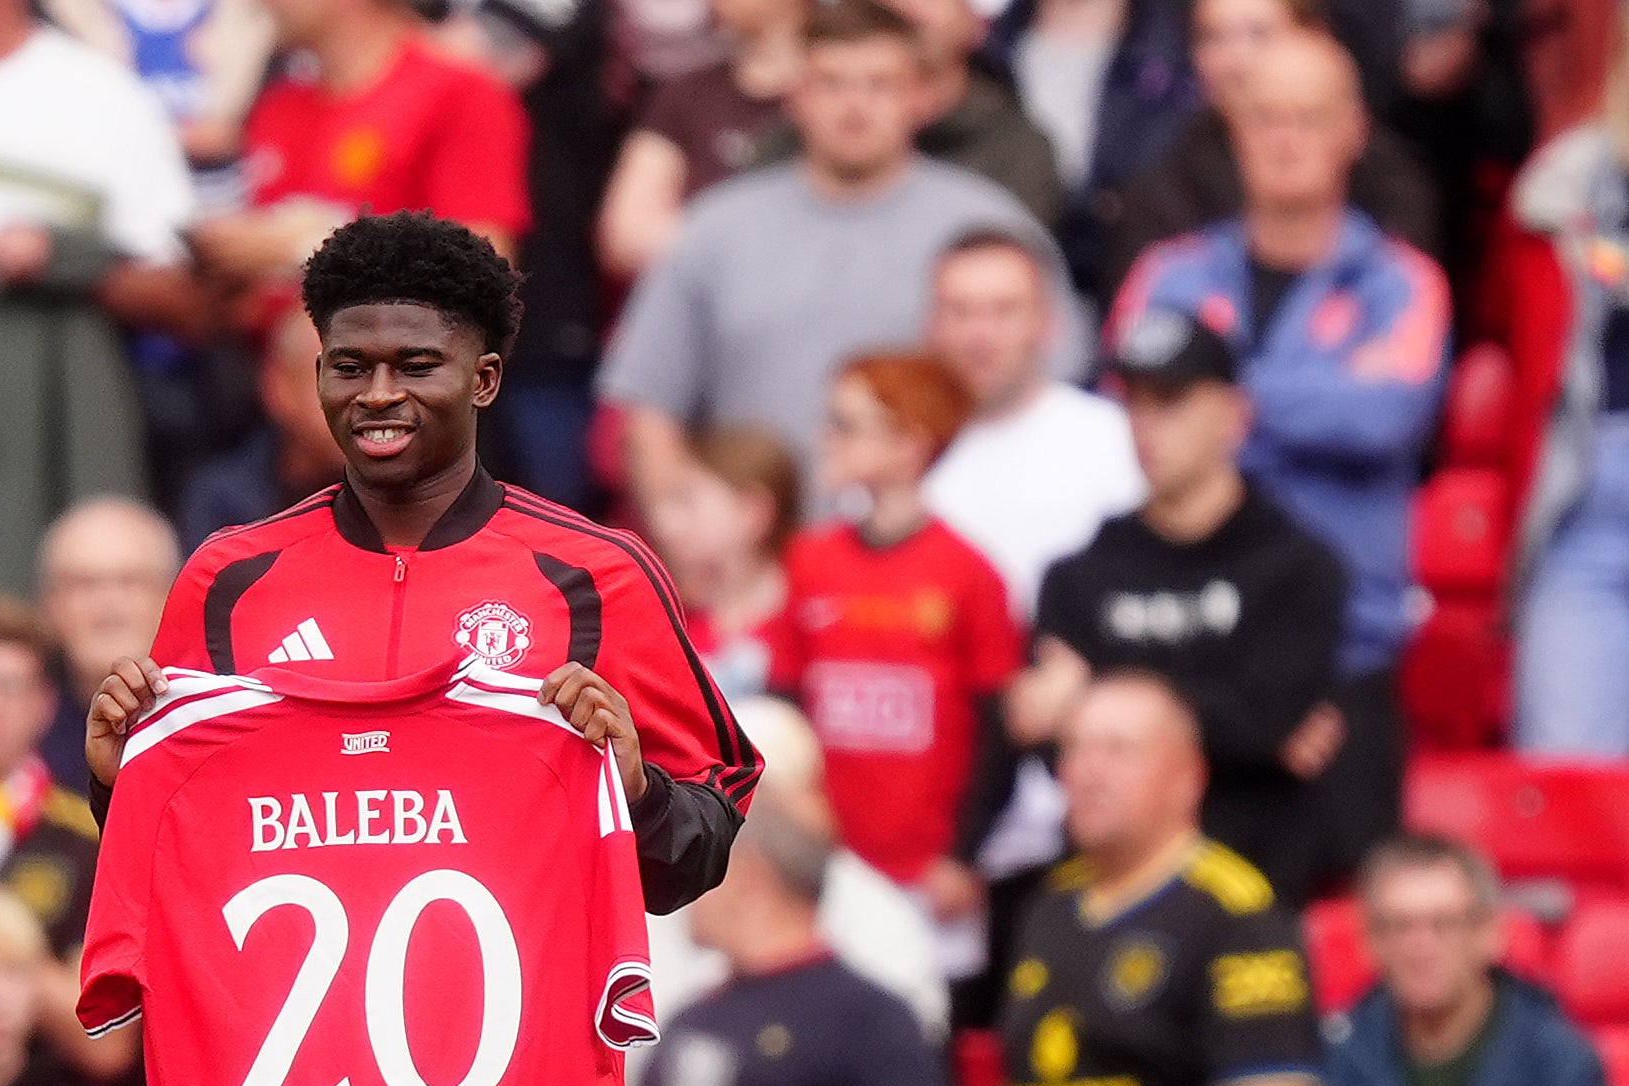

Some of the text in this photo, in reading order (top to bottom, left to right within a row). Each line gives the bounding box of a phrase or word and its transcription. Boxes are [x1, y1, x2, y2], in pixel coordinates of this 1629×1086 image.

[465, 607, 524, 633] MANCHESTER
[344, 735, 388, 751] UNITED
[247, 789, 469, 853] BALEBA
